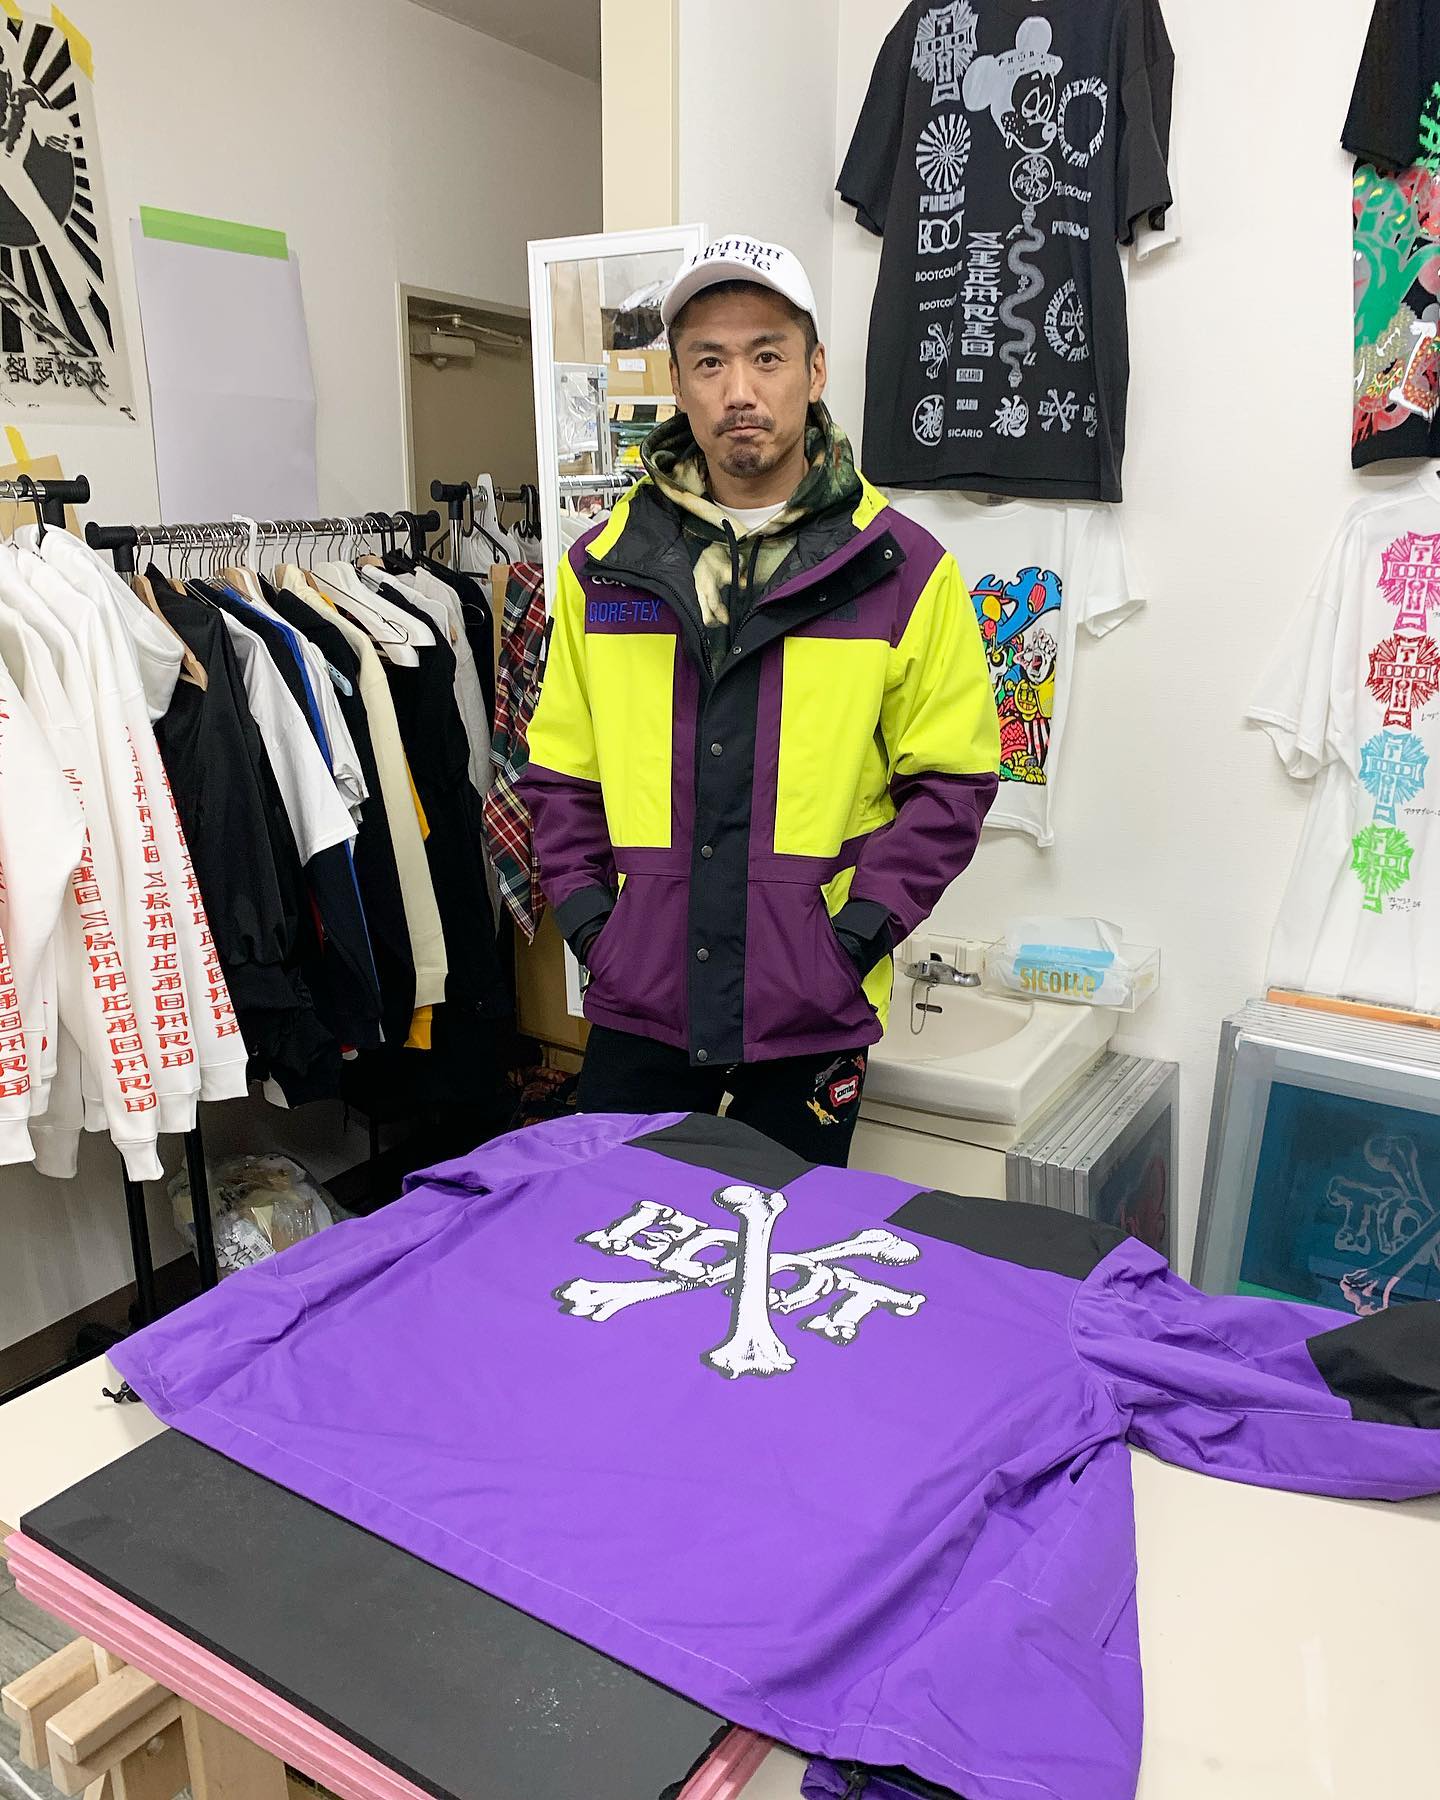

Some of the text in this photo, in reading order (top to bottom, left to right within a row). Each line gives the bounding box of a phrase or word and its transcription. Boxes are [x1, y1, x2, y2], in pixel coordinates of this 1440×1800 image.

[947, 428, 983, 439] SICARIO
[589, 600, 661, 622] GORE-TEX
[574, 1199, 927, 1346] BOOT
